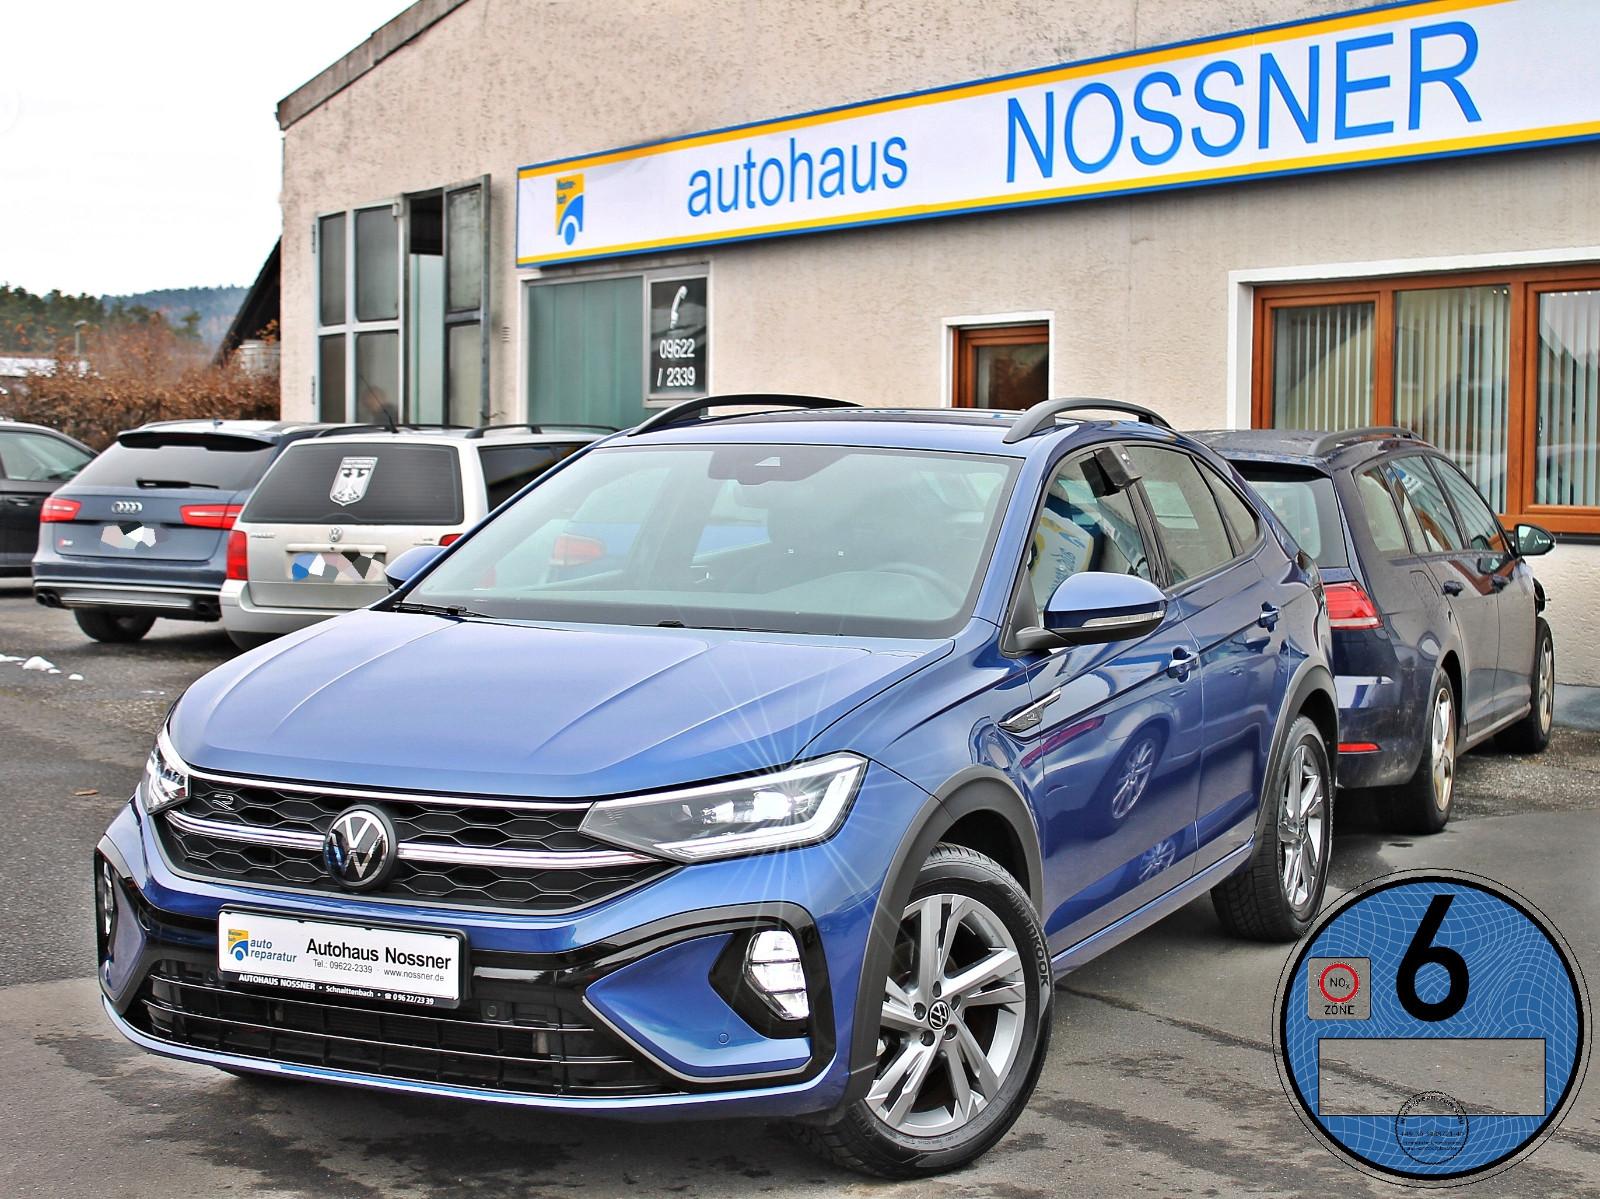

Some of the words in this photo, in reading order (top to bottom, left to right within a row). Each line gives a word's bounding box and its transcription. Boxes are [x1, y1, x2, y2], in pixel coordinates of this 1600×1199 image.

[687, 137, 908, 218] autohaus
[1006, 20, 1483, 184] NOSSNER
[659, 338, 696, 359] 09622
[666, 366, 696, 387] 2339
[250, 939, 273, 949] auto
[305, 938, 379, 962] Autohaus
[385, 946, 452, 970] Nossner
[250, 949, 297, 963] reparatur
[312, 958, 329, 969] Tel.:
[329, 960, 373, 974] 09622-2339
[383, 969, 445, 982] www.nossner.de
[238, 973, 279, 986] AUTOHAUS
[280, 978, 316, 991] NOSSNER
[325, 985, 374, 998] Schnaittenbach
